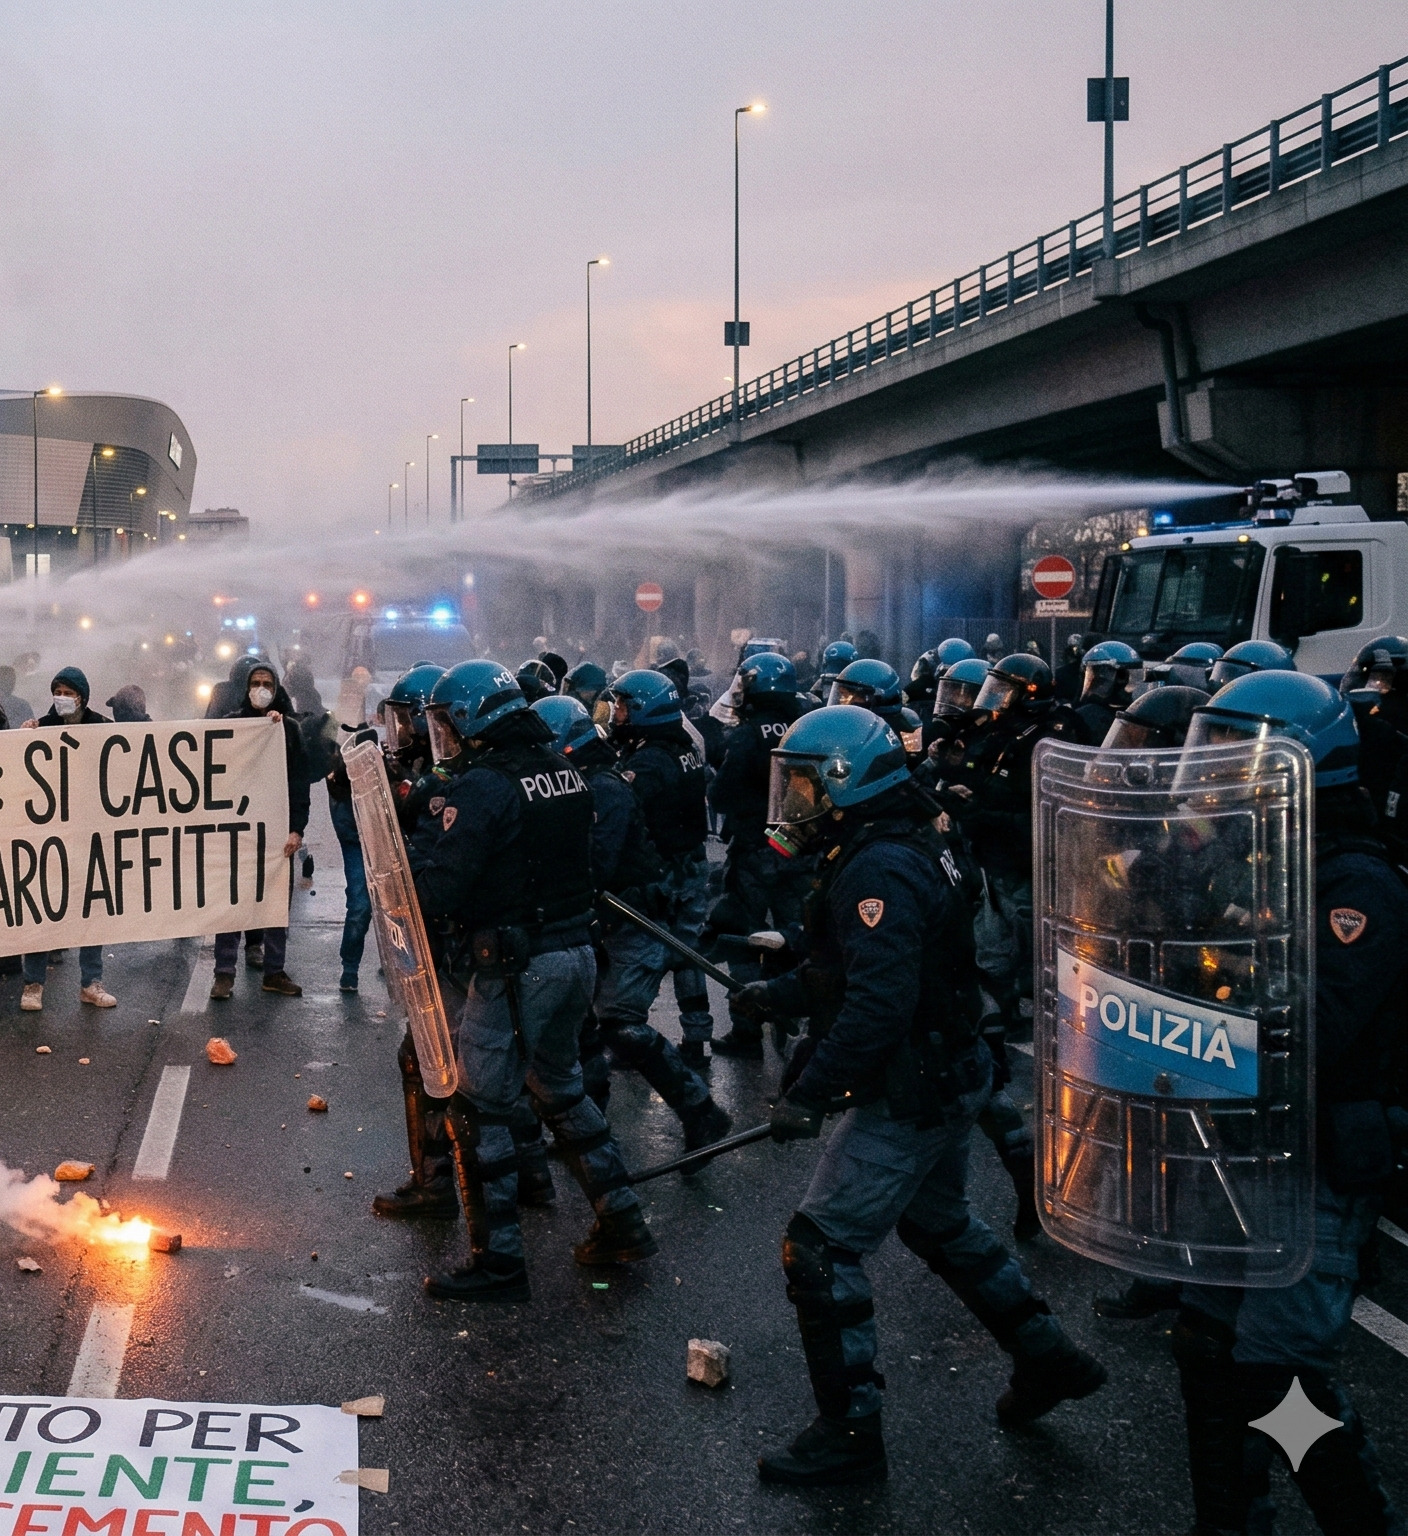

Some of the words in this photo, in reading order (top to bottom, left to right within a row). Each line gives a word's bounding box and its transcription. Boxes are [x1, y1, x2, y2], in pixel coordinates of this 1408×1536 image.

[24, 733, 81, 826] SÌ
[99, 729, 250, 819] CASE,
[520, 769, 589, 802] POLIZIA
[83, 822, 265, 918] AFFITTI
[1079, 983, 1237, 1070] POLIZIA
[139, 1408, 303, 1454] PER
